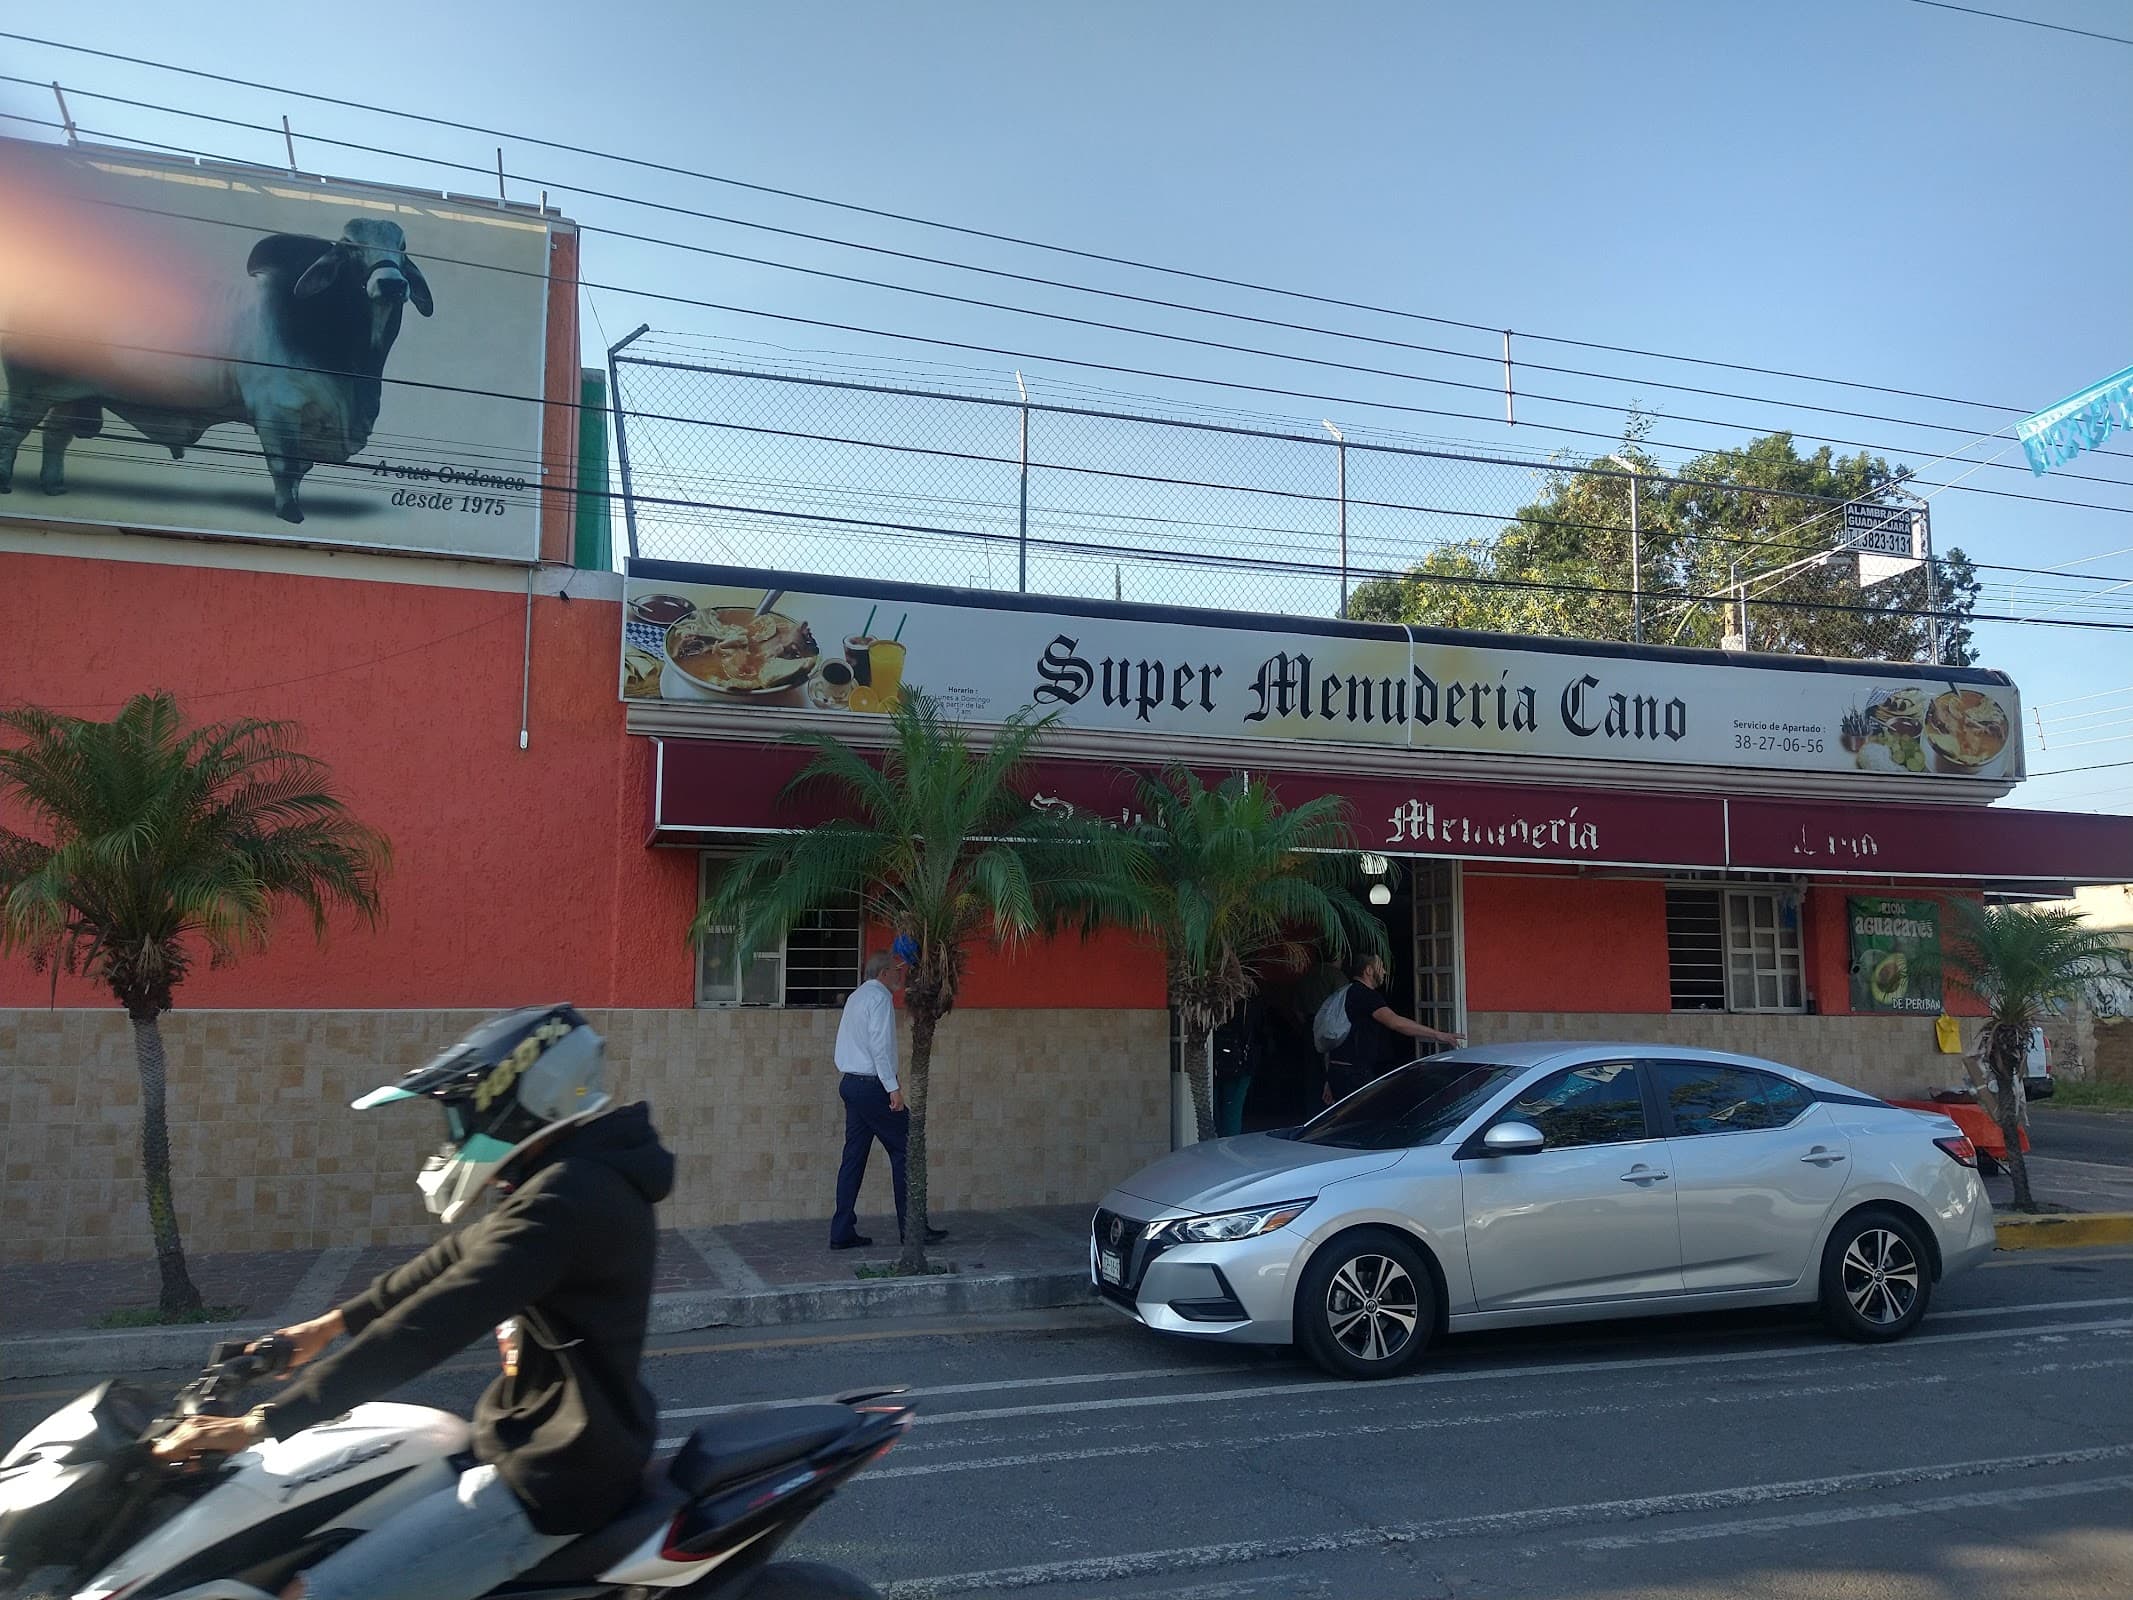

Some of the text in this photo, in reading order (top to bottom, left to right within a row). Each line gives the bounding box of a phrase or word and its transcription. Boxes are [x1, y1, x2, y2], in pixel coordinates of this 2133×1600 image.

[372, 460, 388, 476] A
[391, 489, 505, 516] desde 1975
[1848, 505, 1910, 522] ALAMBRADOS
[948, 686, 974, 694] Horario
[1033, 634, 1686, 742] Super Menudería Cano
[1733, 719, 1767, 730] Servicio
[1769, 722, 1780, 731] de
[1782, 723, 1821, 733] Apartado
[1735, 734, 1824, 753] 38-27-06-56
[1881, 902, 1906, 914] RICOS
[1893, 998, 1903, 1009] DE
